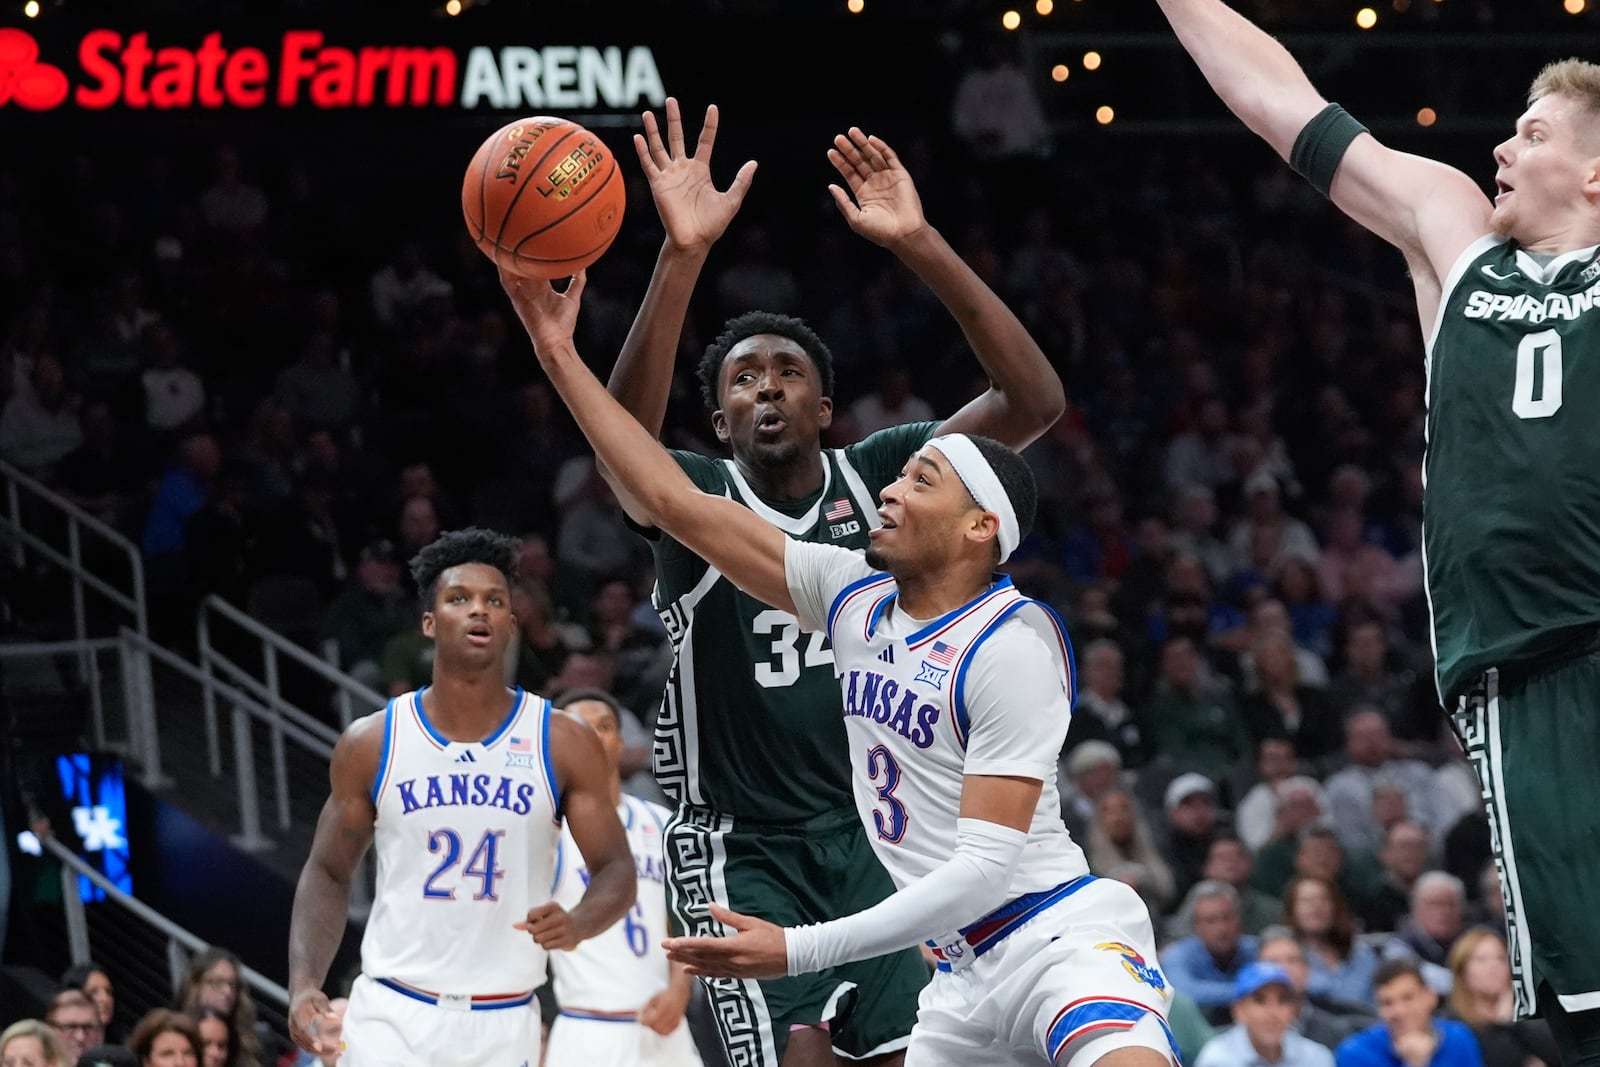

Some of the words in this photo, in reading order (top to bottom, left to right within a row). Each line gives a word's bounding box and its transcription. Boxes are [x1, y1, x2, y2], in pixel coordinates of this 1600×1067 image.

[76, 30, 269, 109] State
[278, 31, 457, 109] Farm
[461, 46, 667, 108] ARENA
[496, 121, 564, 185] SPALD
[536, 136, 597, 198] LEGACY
[1512, 328, 1563, 419] 0
[840, 671, 940, 749] ANSAS
[396, 773, 534, 815] KANSAS
[866, 744, 909, 844] 3
[423, 828, 506, 902] 24
[625, 900, 648, 957] 6
